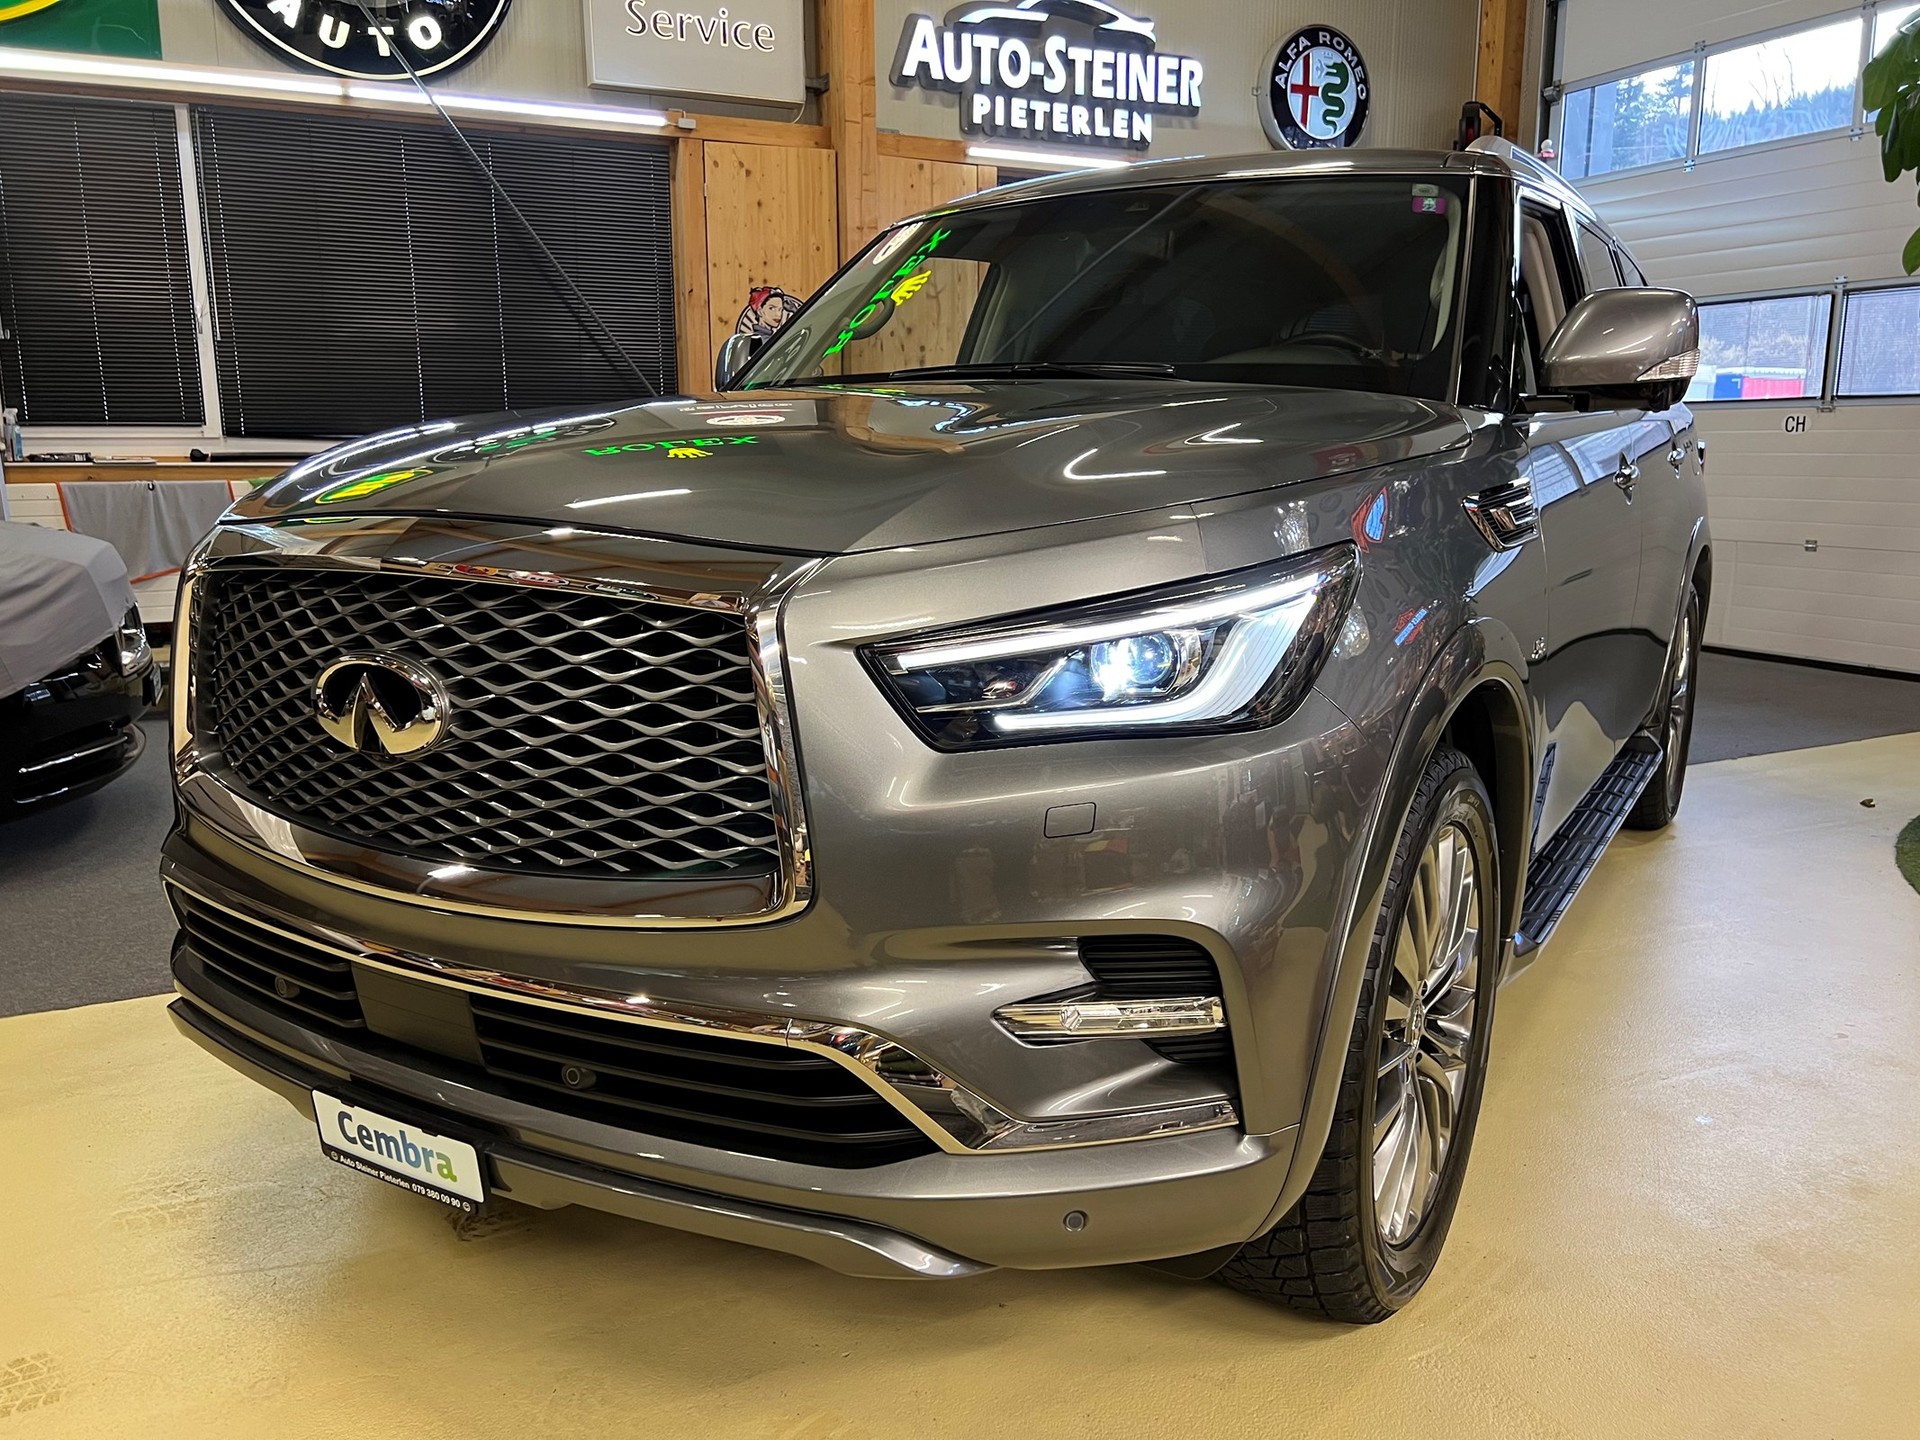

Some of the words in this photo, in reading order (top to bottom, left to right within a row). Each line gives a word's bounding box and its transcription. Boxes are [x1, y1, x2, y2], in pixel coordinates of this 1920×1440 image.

[267, 0, 442, 56] AUTO
[625, 0, 775, 51] Service
[902, 18, 1204, 107] AUTO-STEINER
[1275, 36, 1312, 89] ALFA
[1318, 31, 1367, 100] ROMEO
[972, 94, 1153, 143] PIETERLEN
[1785, 415, 1806, 433] CH
[338, 1110, 458, 1183] Cembra
[340, 1155, 356, 1168] Auto
[355, 1161, 379, 1177] Steiner
[379, 1170, 410, 1190] Pieterlen
[411, 1183, 426, 1195] 079
